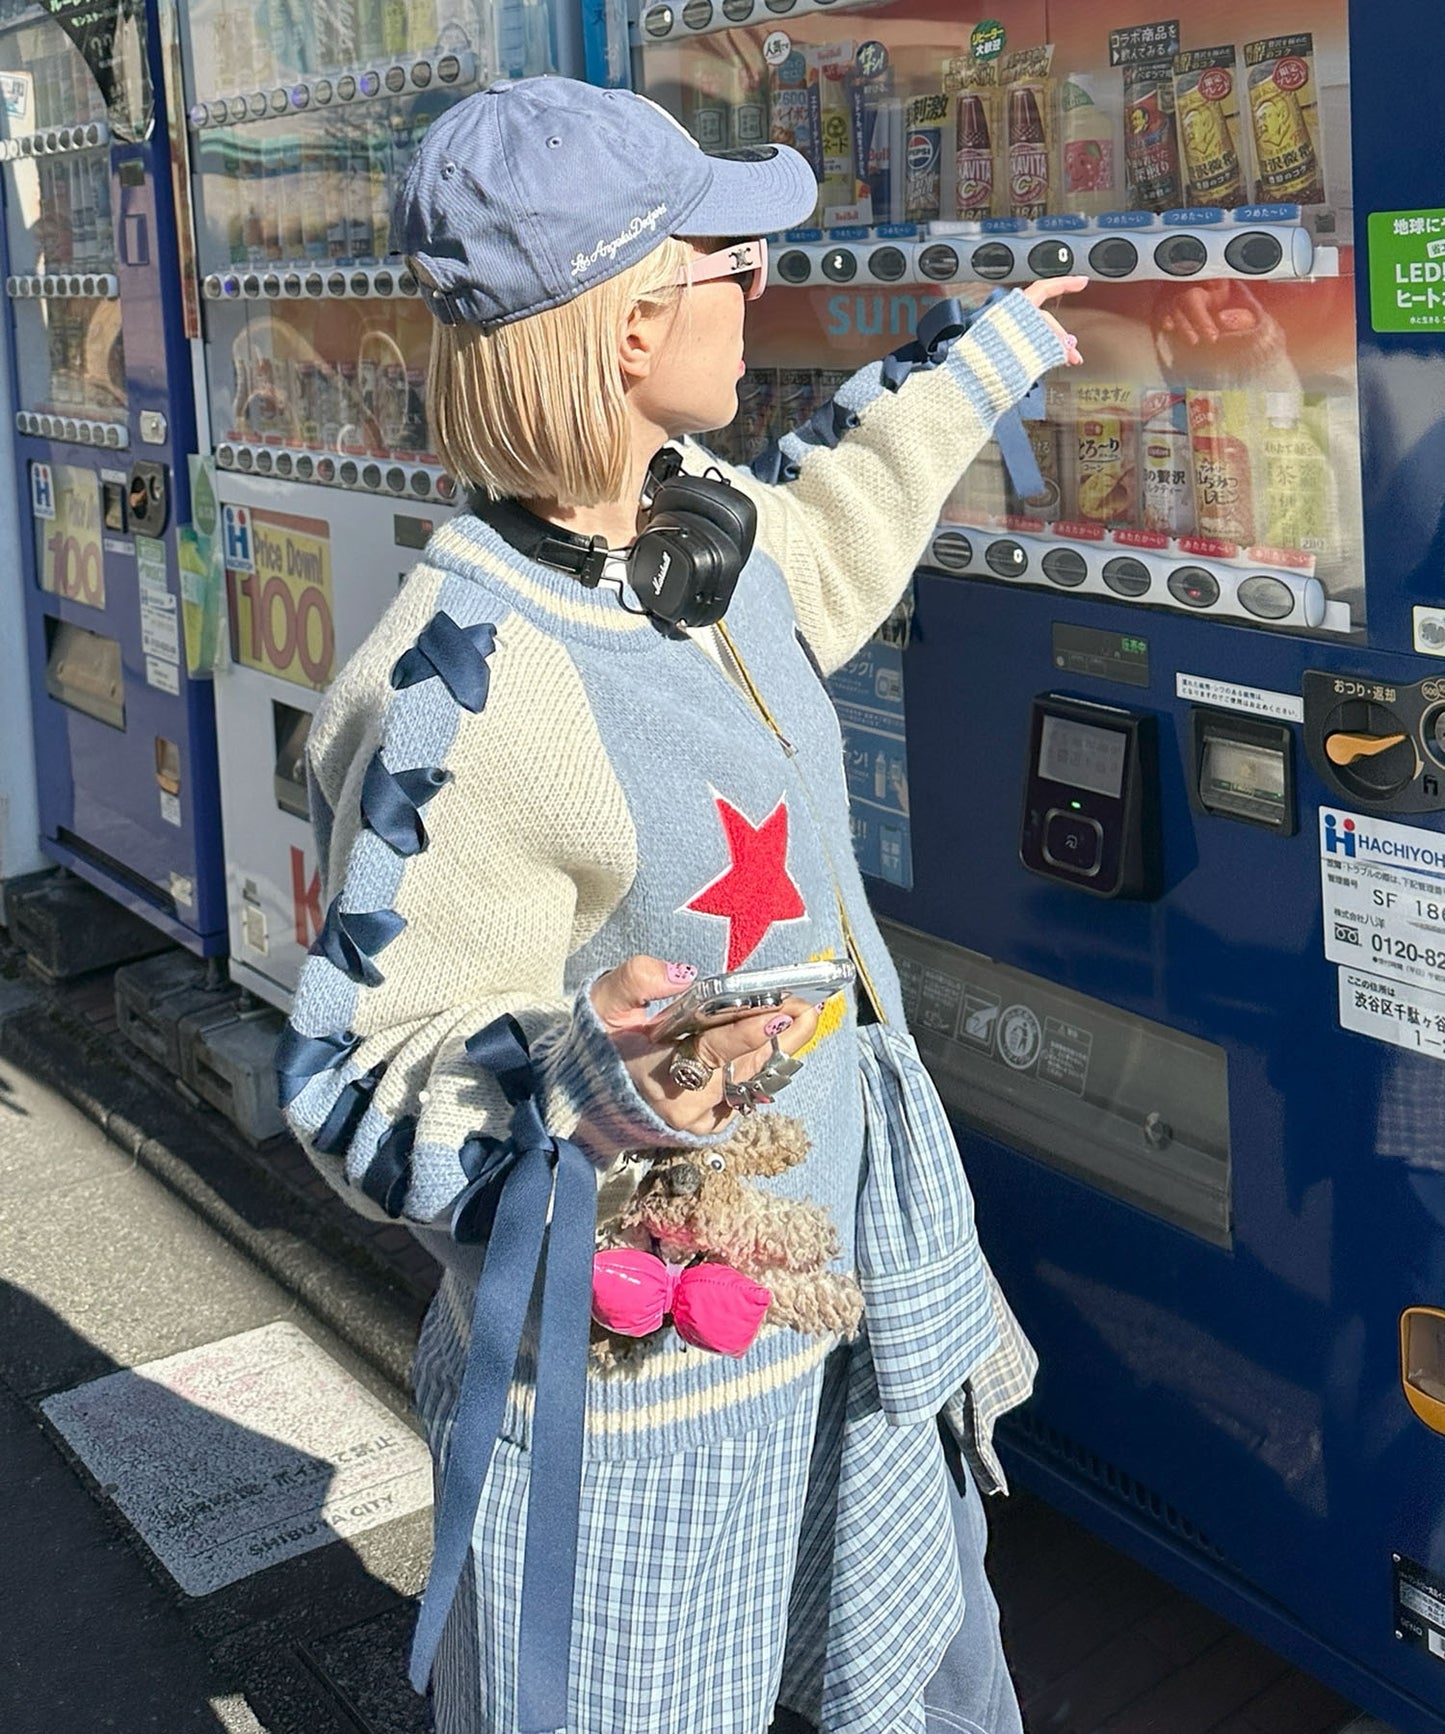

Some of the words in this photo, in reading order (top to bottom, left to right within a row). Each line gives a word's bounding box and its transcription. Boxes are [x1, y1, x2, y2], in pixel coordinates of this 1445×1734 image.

[972, 28, 1004, 45] リピーター
[975, 39, 1001, 56] 大歓迎
[1111, 25, 1178, 48] コラボ商品を
[1105, 214, 1145, 225] つめた〜い
[1171, 211, 1214, 222] つめた〜い
[1244, 207, 1288, 218] つめた〜い
[1118, 531, 1165, 546] あたたか〜い
[1183, 538, 1237, 554] あたたか〜い
[48, 531, 103, 604] 100
[253, 530, 283, 574] Price
[286, 537, 324, 586] Down!
[241, 574, 335, 684] 100
[1334, 680, 1397, 702] おつり・返却
[1358, 834, 1445, 868] HACHIYOH
[1372, 889, 1398, 909] SF
[1334, 907, 1385, 930] 株式会社八洋
[1347, 975, 1396, 997] ここの住所は
[352, 1492, 396, 1518] CITY
